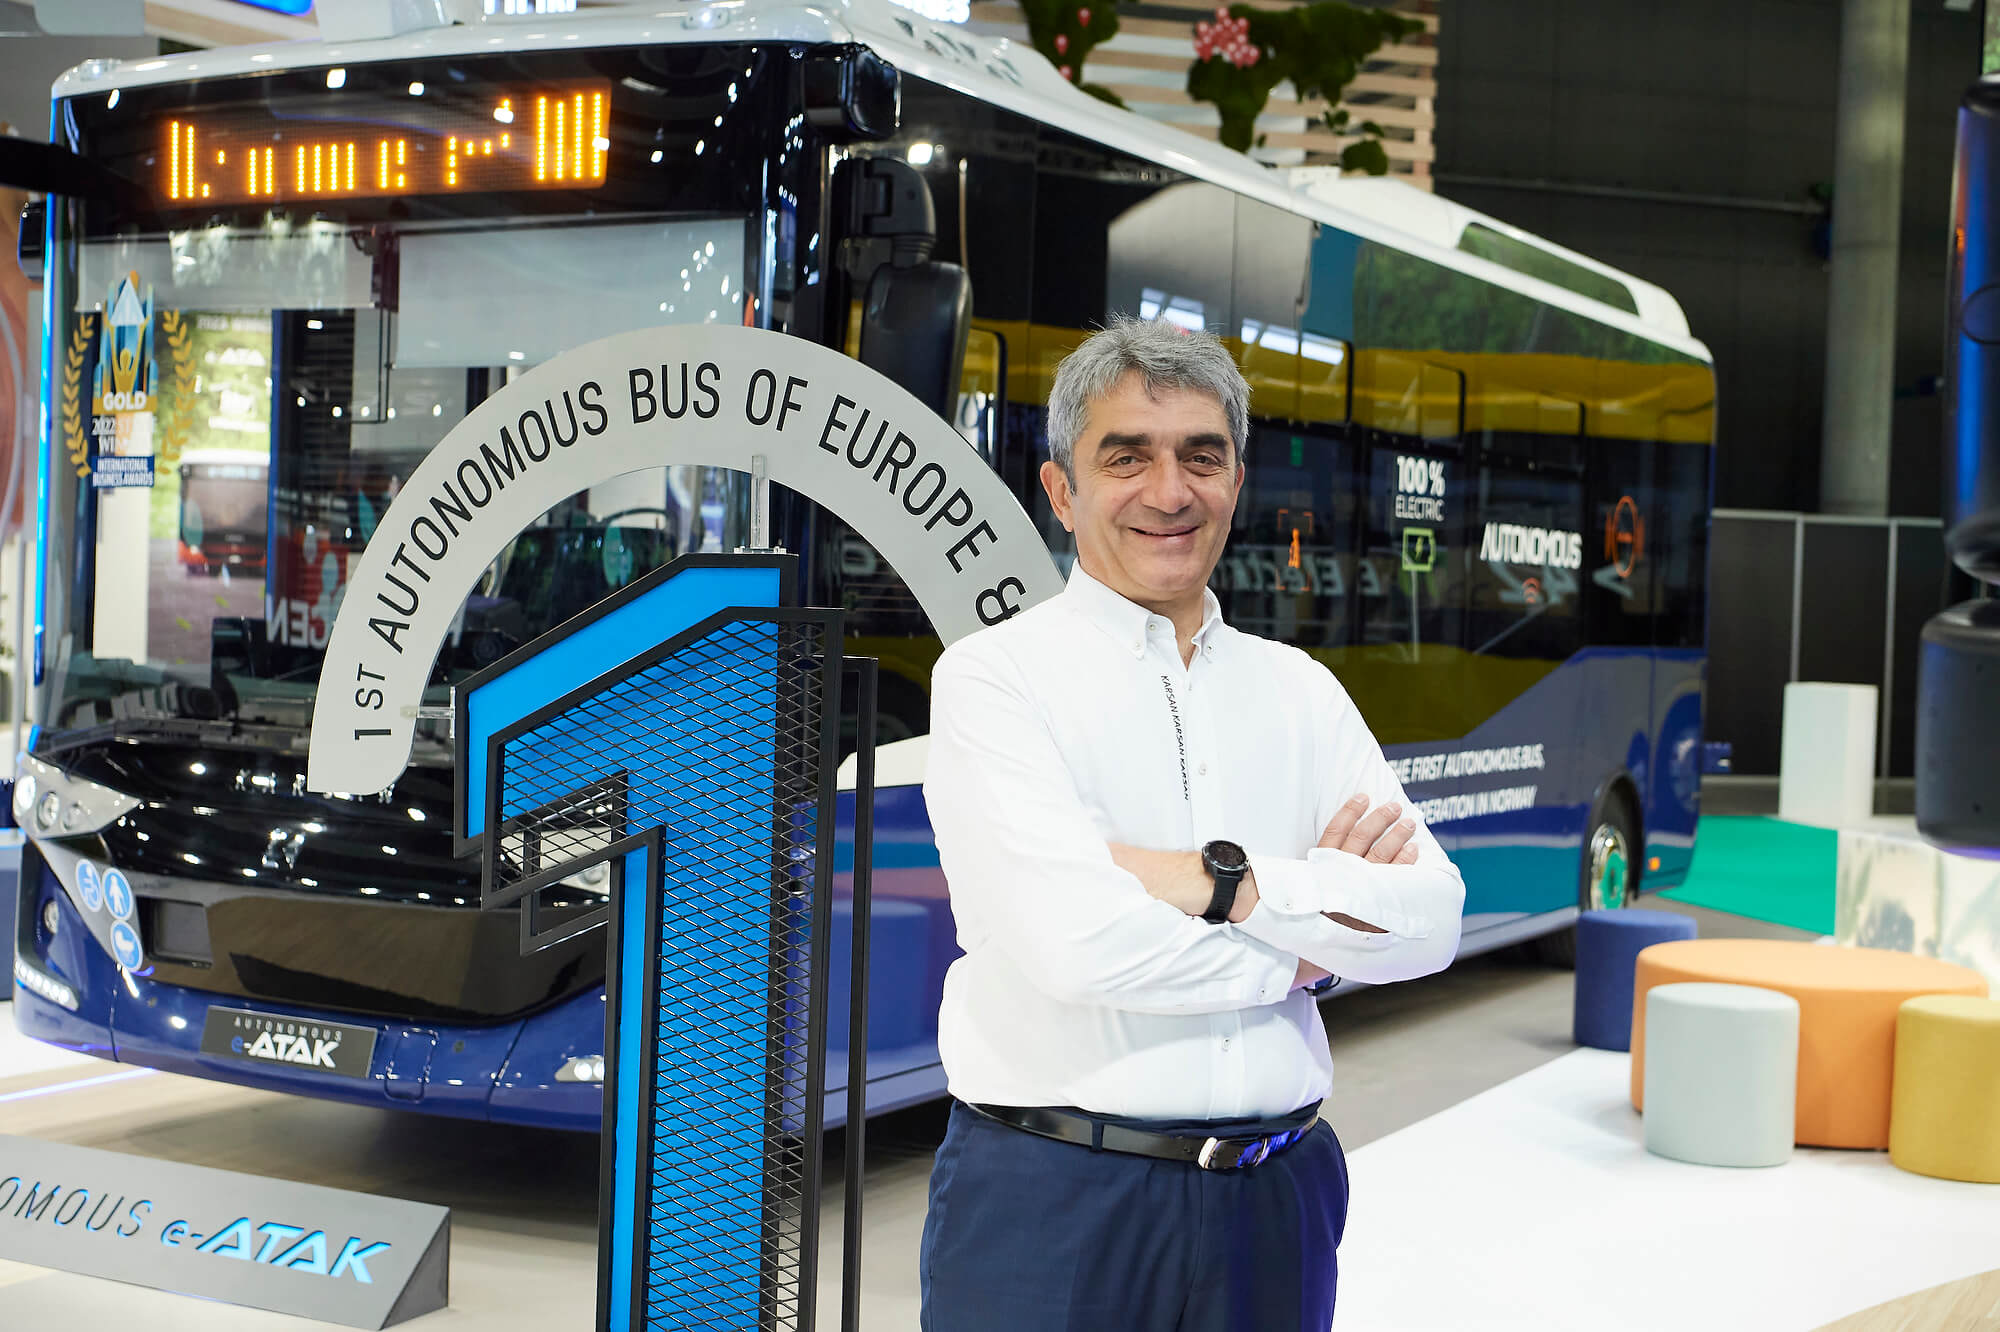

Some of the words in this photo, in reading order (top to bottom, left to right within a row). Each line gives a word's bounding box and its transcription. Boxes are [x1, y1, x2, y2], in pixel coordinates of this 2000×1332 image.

[103, 390, 147, 411] GOLD
[368, 381, 608, 654] AUTONOMOUS
[629, 362, 721, 424] BUS
[745, 368, 809, 432] OF
[818, 394, 999, 574] EUROPE
[975, 576, 1027, 626] &
[1395, 494, 1446, 522] ELECTRIC
[1480, 521, 1583, 571] AUTONOMOUS
[1160, 674, 1179, 714] KARSAN
[1172, 714, 1185, 756] KARSAN
[1180, 757, 1189, 801] KARSAN
[1411, 753, 1447, 783] FIRST
[1443, 745, 1521, 778] AUTONOMOUS
[1414, 793, 1474, 825] PERATION
[1474, 792, 1488, 817] IN
[1488, 785, 1538, 814] NORWAY
[233, 1015, 344, 1042] AUTONOMOUS
[231, 1031, 340, 1068] e-ATAK
[160, 1216, 392, 1284] e-ATAK
